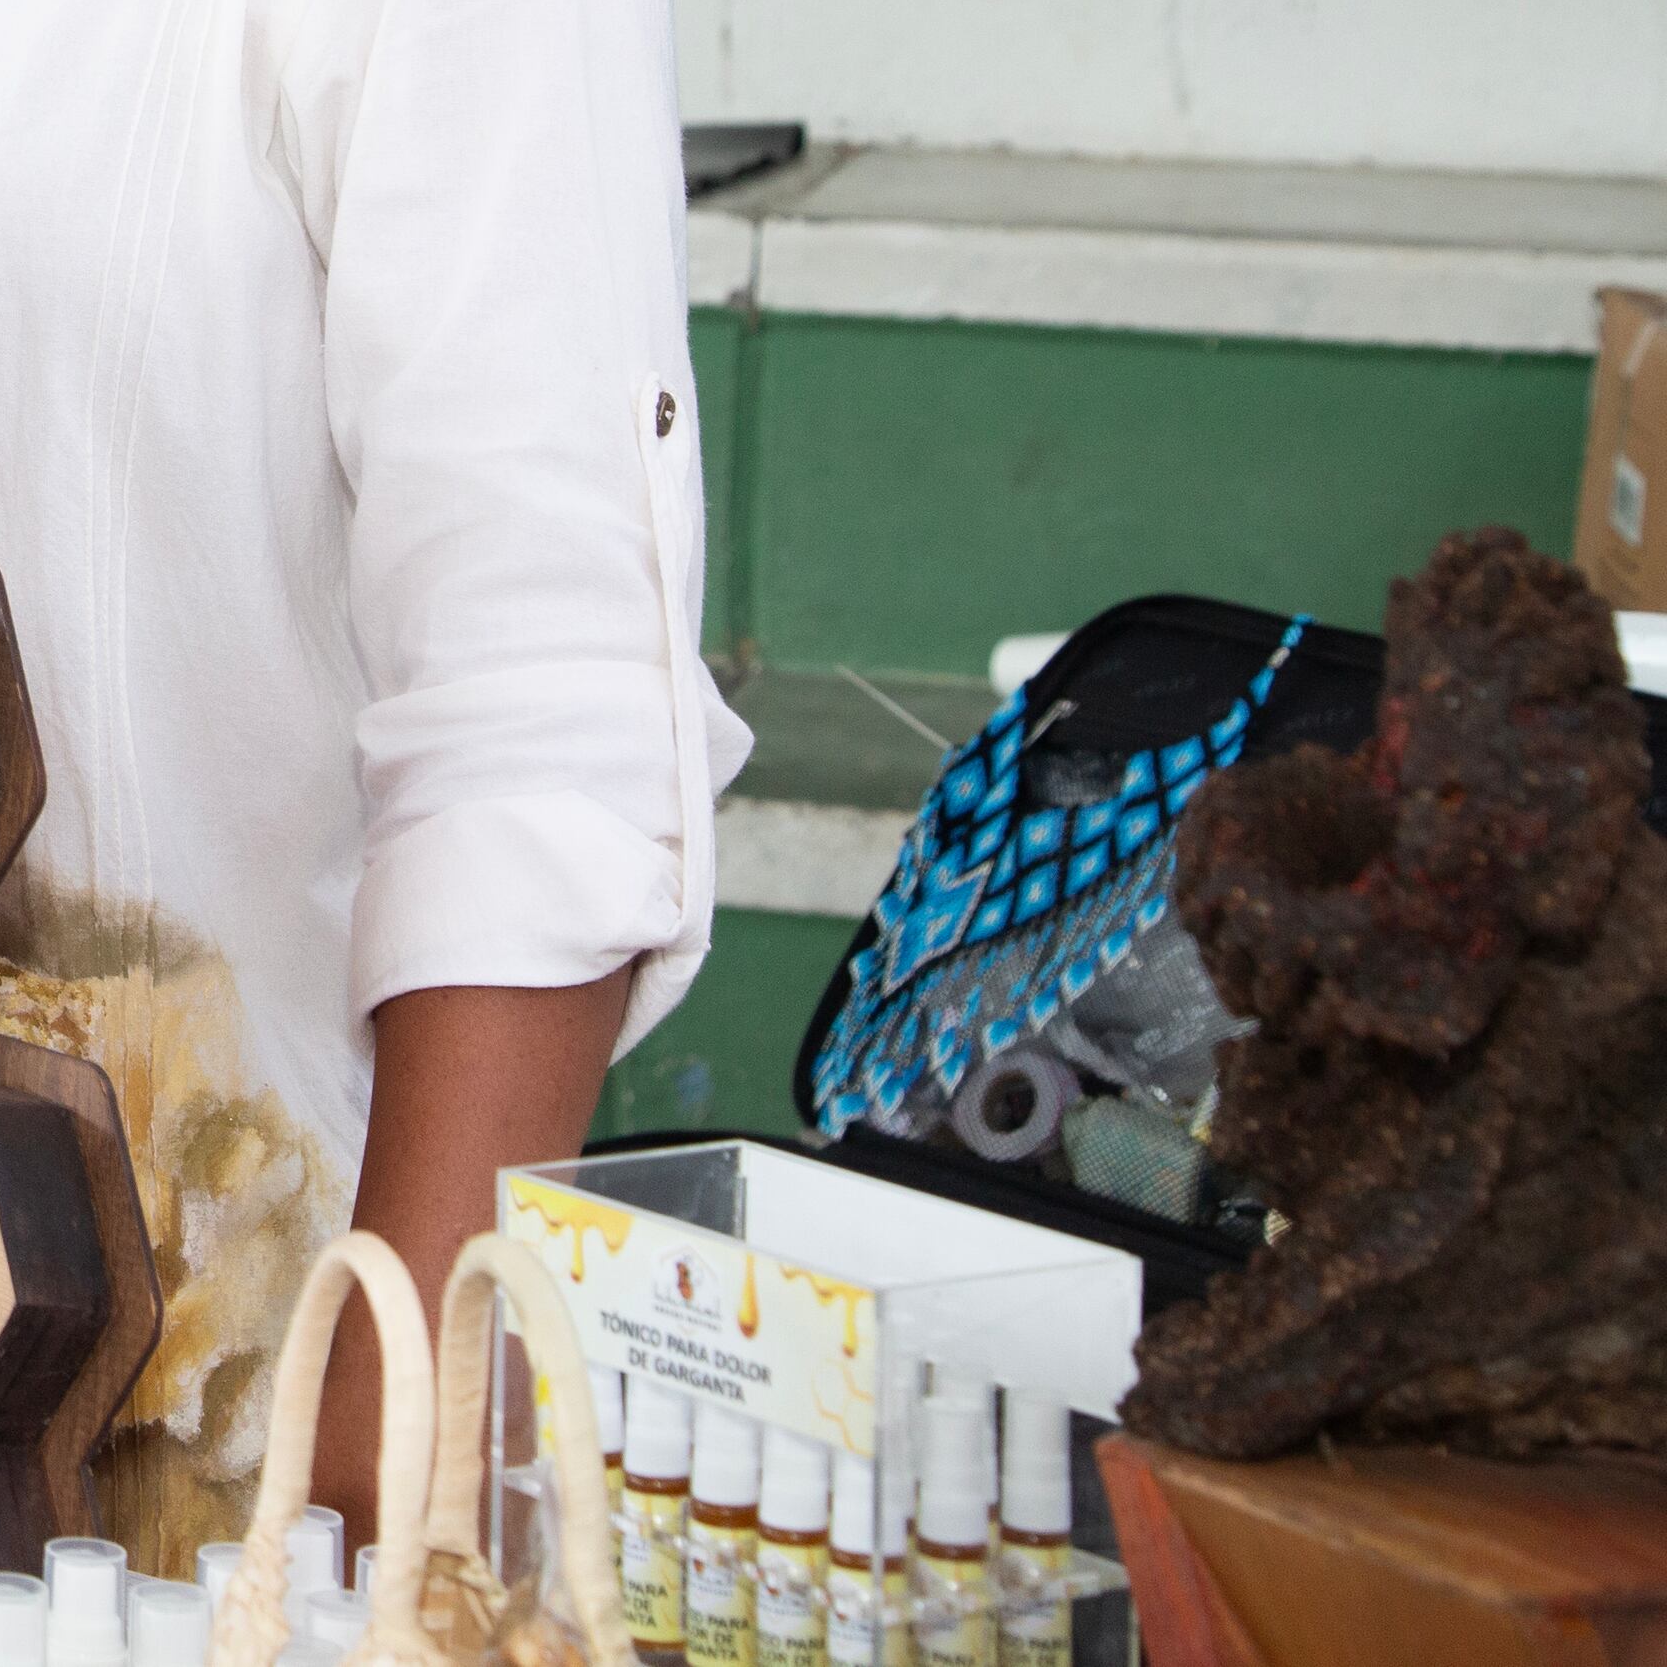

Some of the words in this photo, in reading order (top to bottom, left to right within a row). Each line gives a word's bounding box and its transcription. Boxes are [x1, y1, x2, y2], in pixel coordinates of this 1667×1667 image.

[600, 1311, 661, 1347] TÓNICO
[667, 1334, 709, 1363] PARA
[714, 1350, 772, 1384] DOLOR
[629, 1347, 648, 1369] DE
[655, 1356, 745, 1402] GARGANTA
